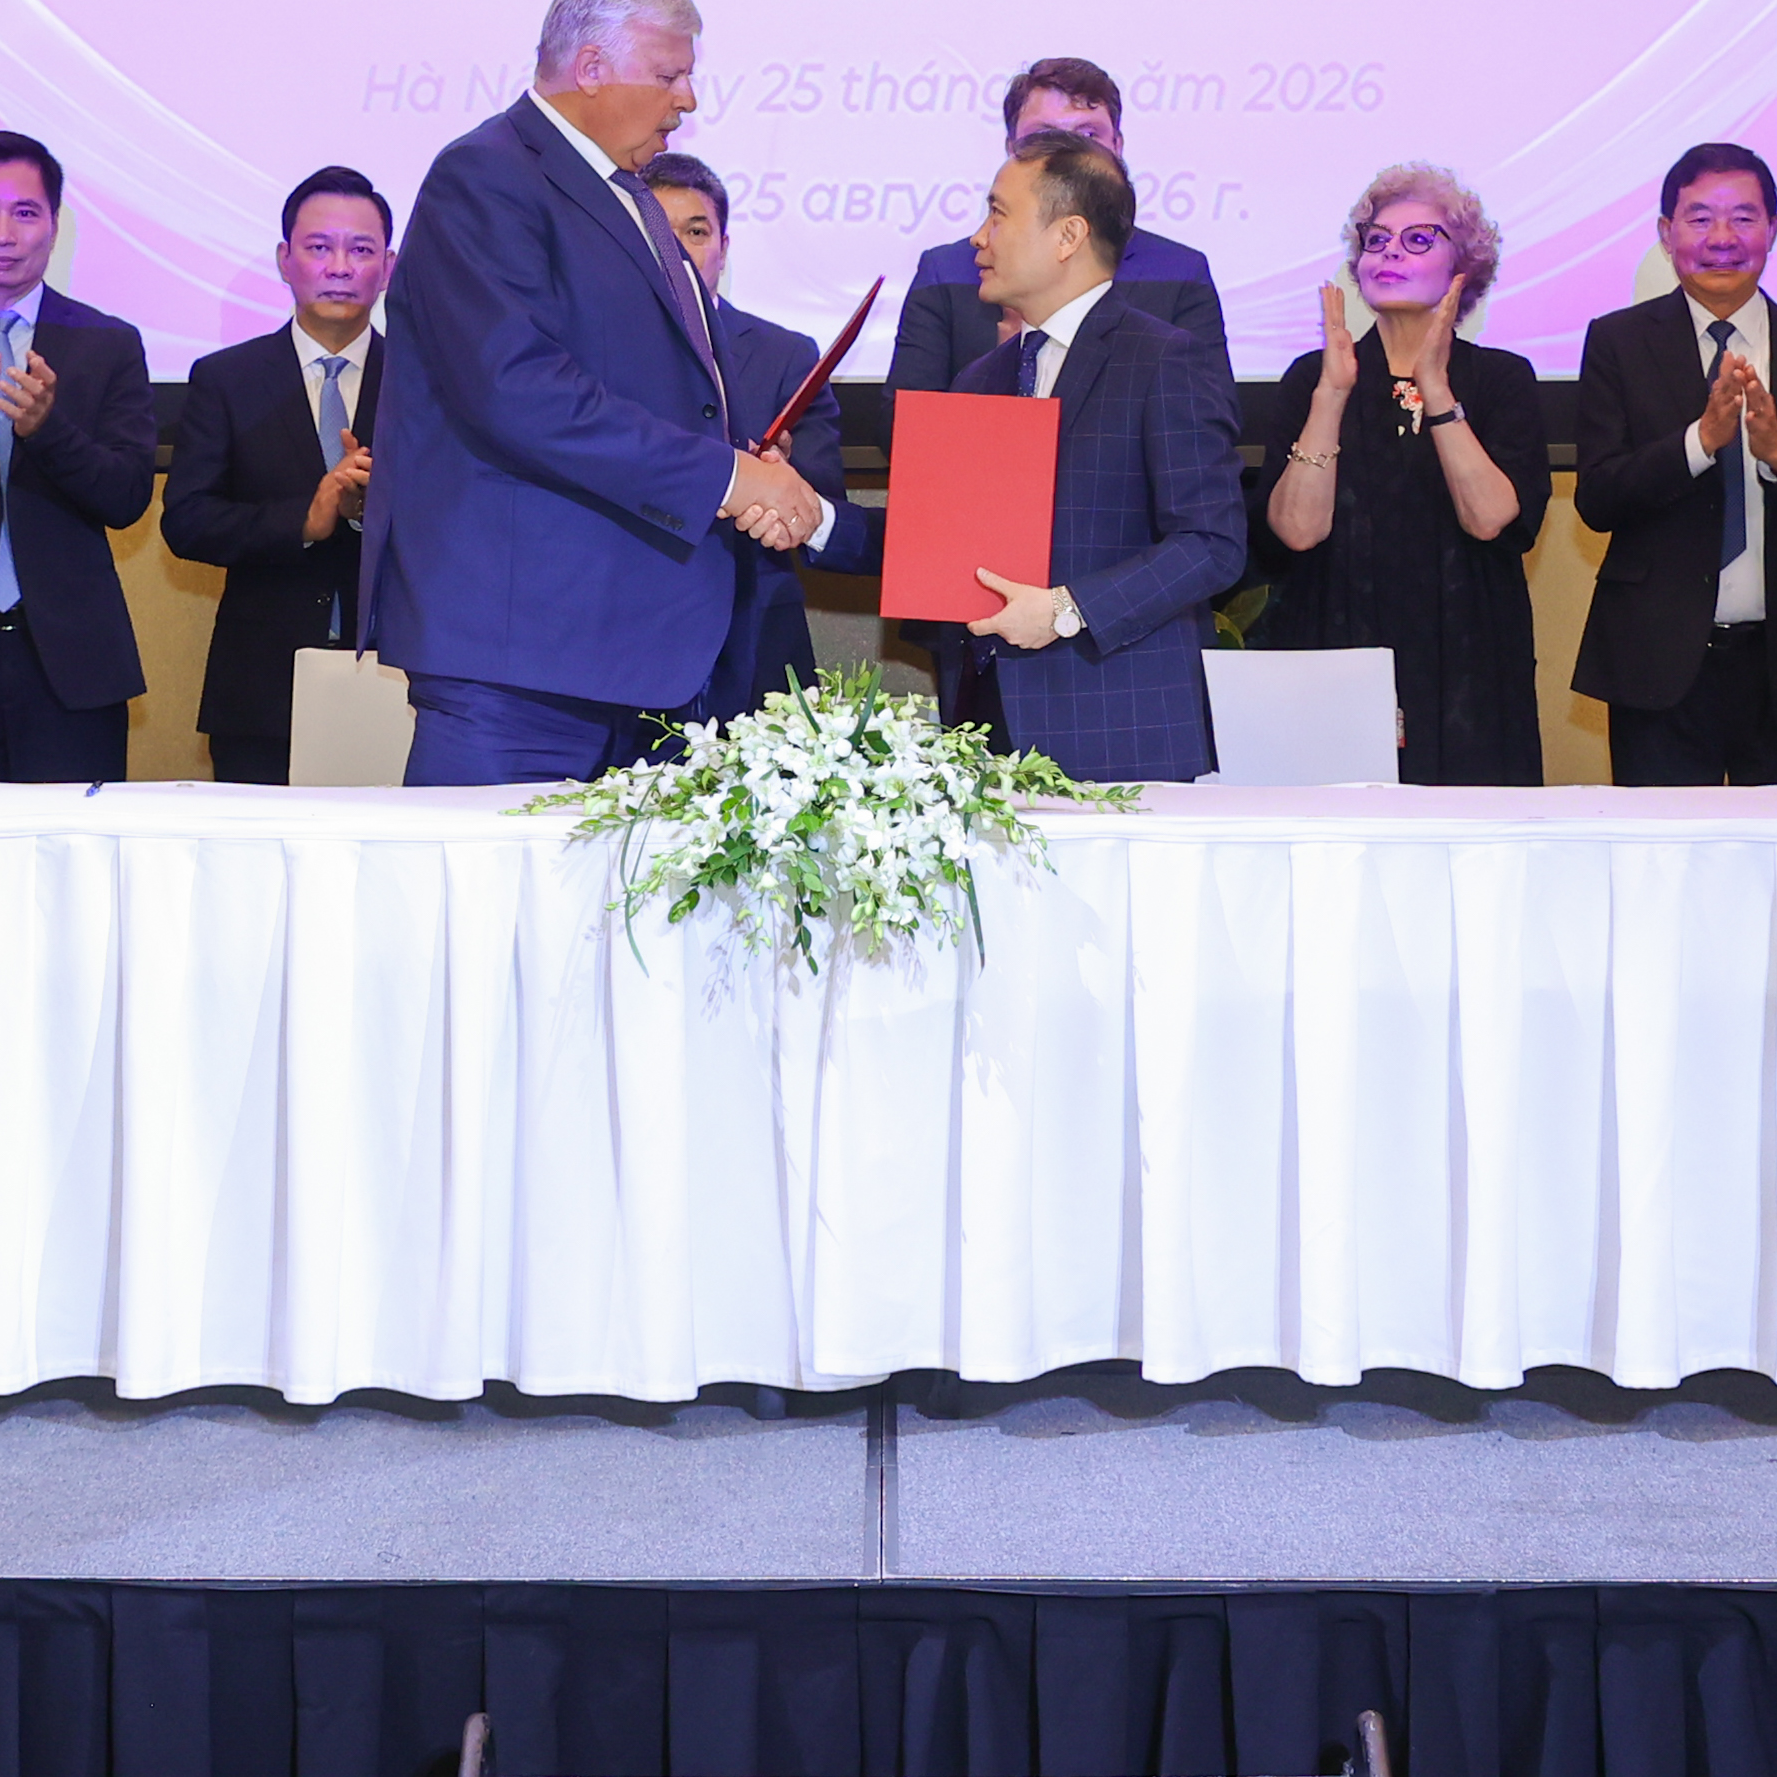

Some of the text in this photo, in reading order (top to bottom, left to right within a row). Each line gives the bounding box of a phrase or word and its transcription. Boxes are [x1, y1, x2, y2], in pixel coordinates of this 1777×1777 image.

[361, 60, 441, 113] Hà
[755, 62, 825, 112] 25
[1119, 60, 1226, 112] ăm
[1243, 62, 1385, 112] 2026
[725, 171, 1249, 233] 25 август 26 г.
